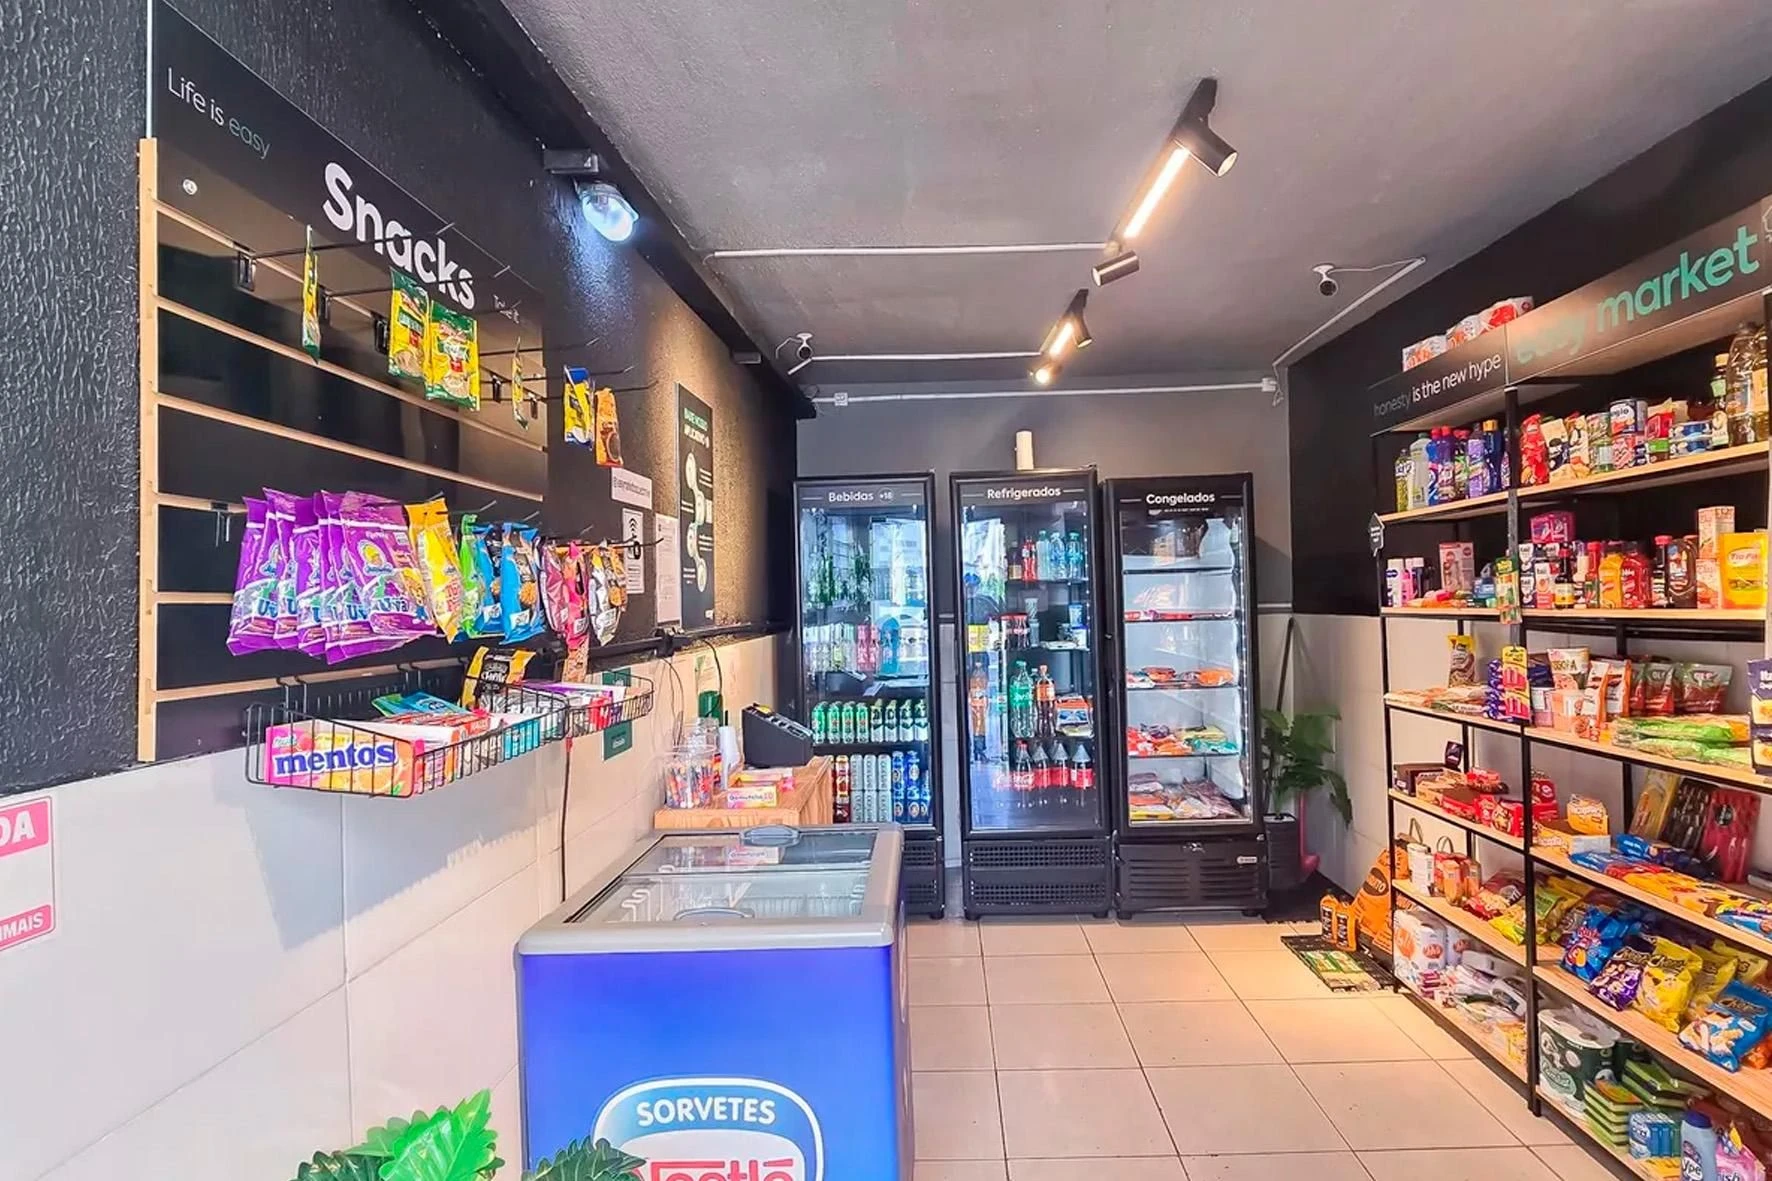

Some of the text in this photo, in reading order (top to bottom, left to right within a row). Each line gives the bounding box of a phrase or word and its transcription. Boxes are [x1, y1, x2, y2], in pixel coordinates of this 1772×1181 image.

[168, 67, 271, 160] Life is easy
[322, 162, 476, 310] Snacks
[1597, 224, 1761, 334] market
[1373, 353, 1502, 417] honesty is the new hype
[828, 490, 875, 502] Bebidas
[986, 486, 1062, 501] Refrigerados
[1145, 492, 1216, 507] Congelados
[275, 742, 396, 775] mentos
[636, 1096, 777, 1127] SORVETES
